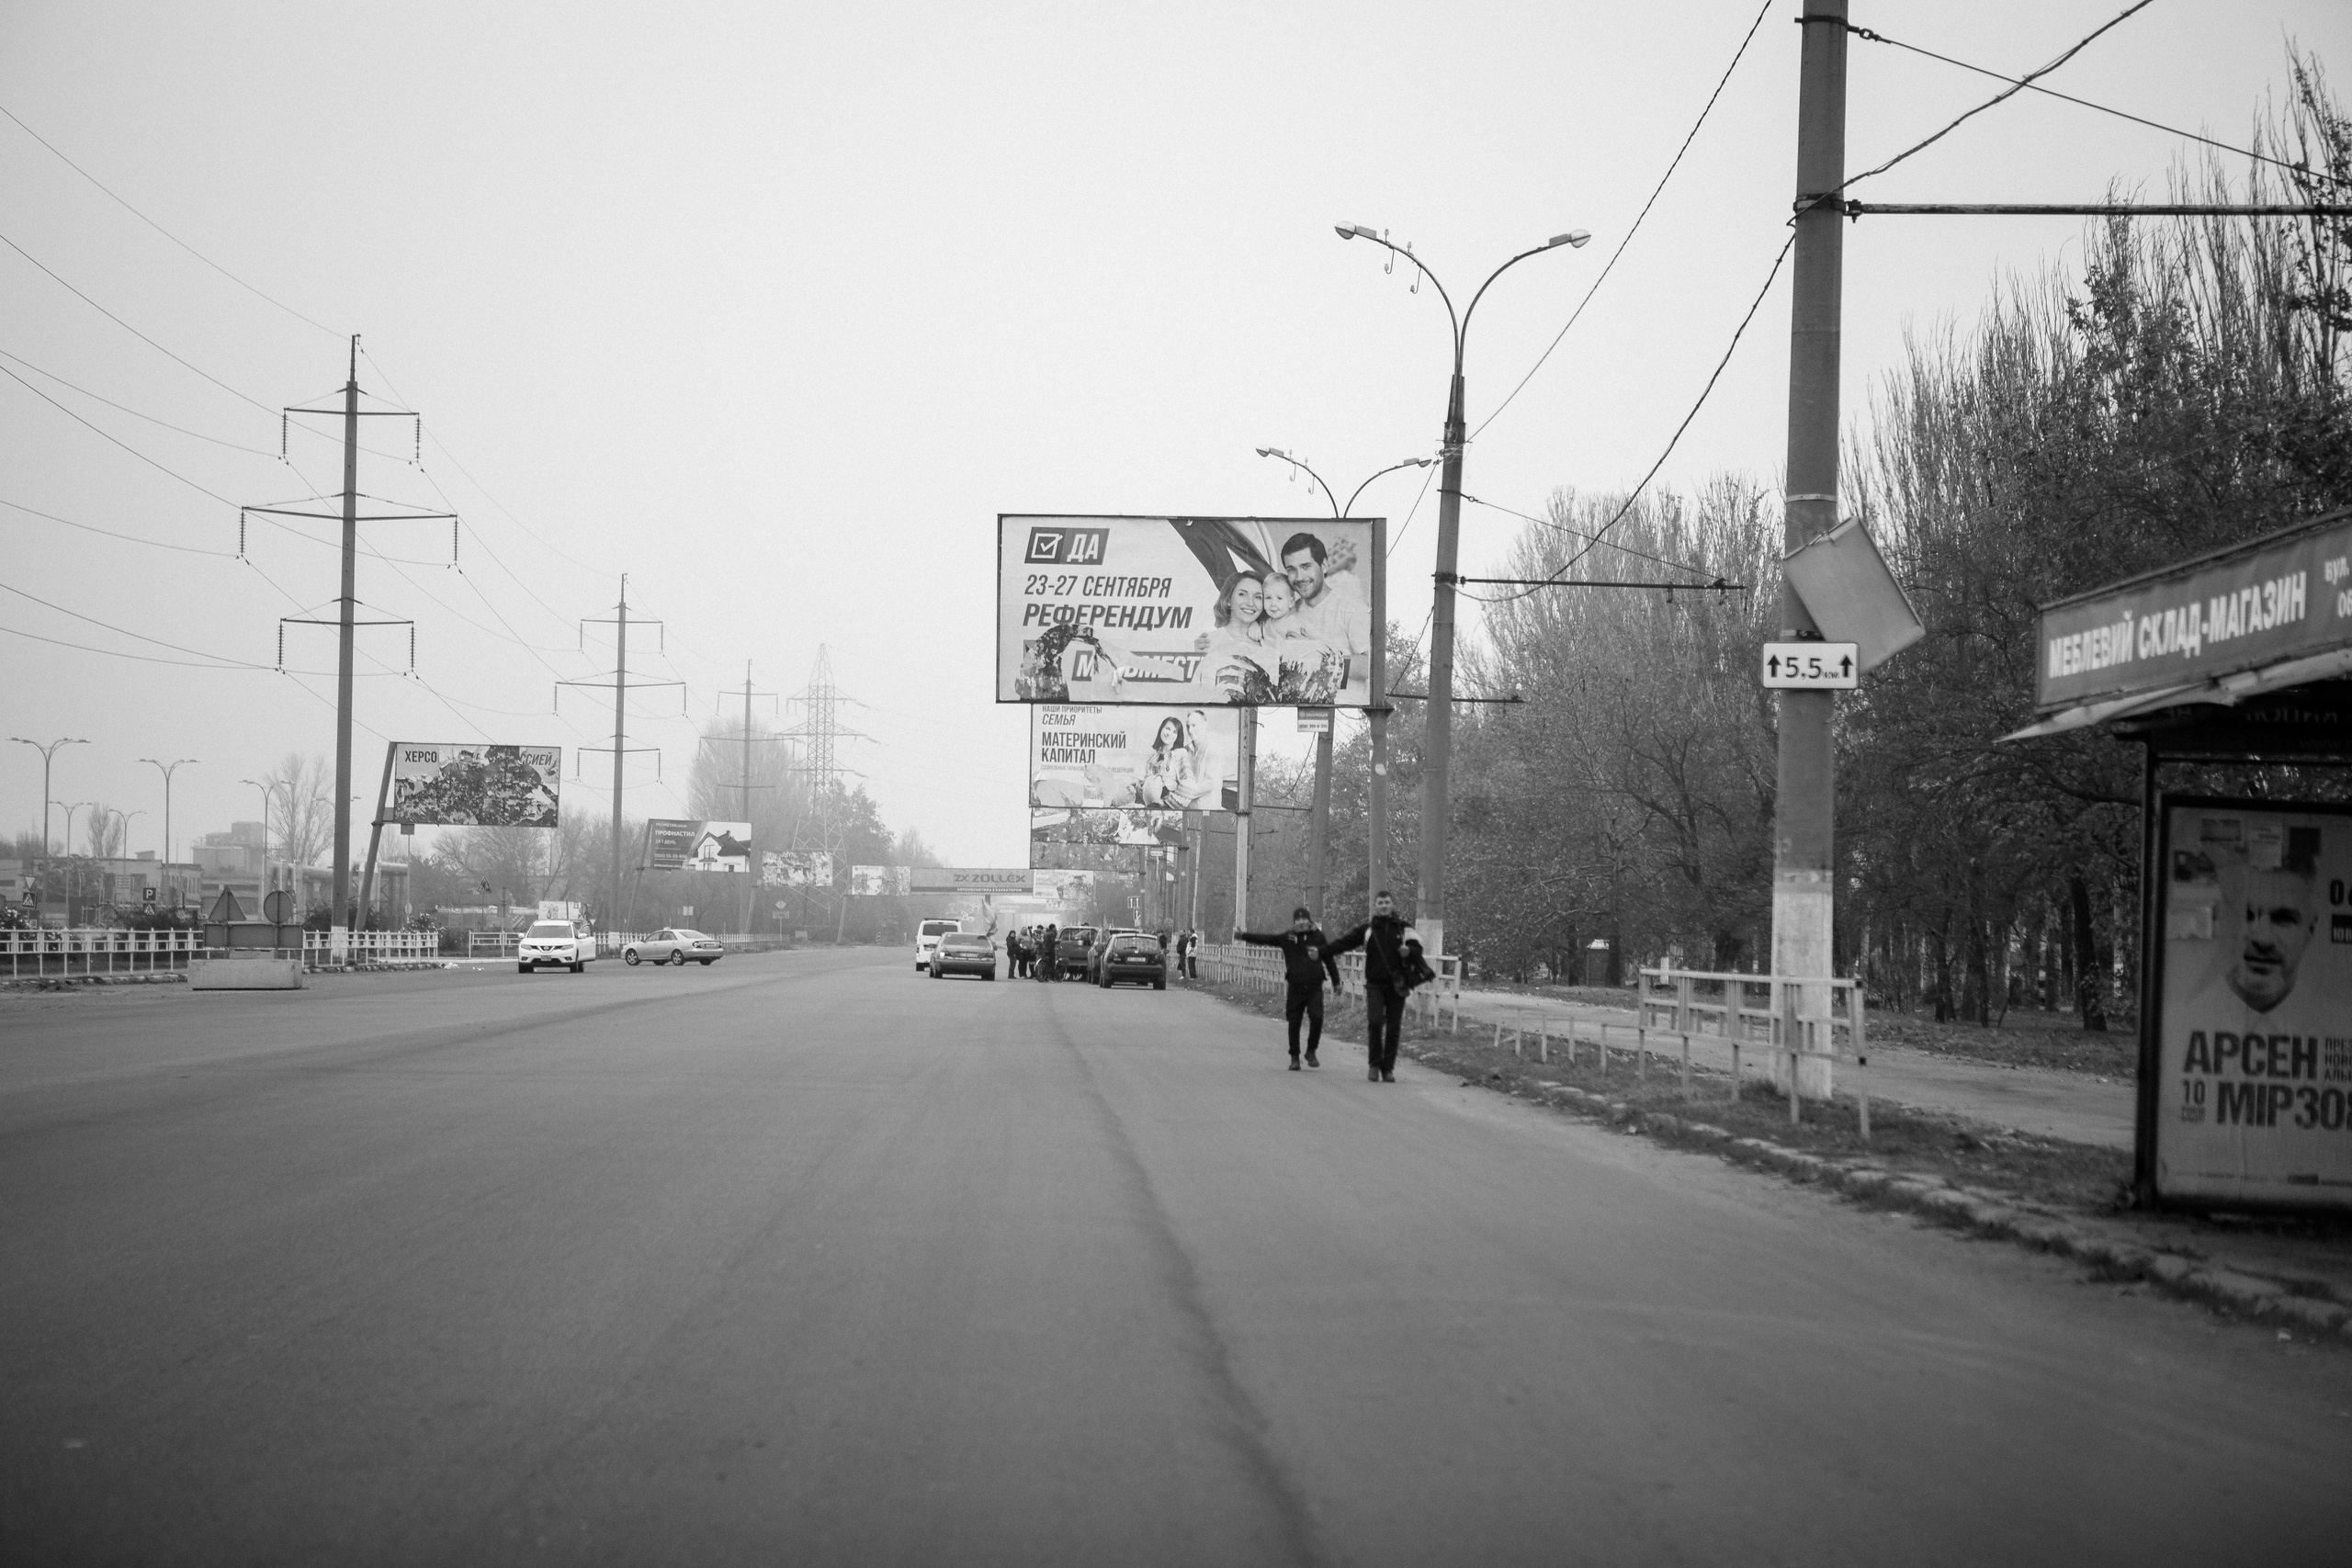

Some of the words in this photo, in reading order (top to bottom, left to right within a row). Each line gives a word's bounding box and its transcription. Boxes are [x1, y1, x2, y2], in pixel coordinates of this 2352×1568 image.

[1067, 533, 1099, 563] ДА
[1024, 574, 1078, 597] 23-27
[1082, 575, 1172, 599] СЕНТЯБРЯ
[1023, 603, 1193, 632] РЕФЕРЕНДУМ
[2048, 610, 2134, 679] МЕБЛЕВИЙ
[2138, 571, 2307, 660] СКЛАД-МАГАЗИН
[1076, 654, 1096, 678] М
[1785, 657, 1822, 680] 5,5
[1042, 714, 1076, 726] СЕМЬЯ
[1062, 705, 1102, 714] ПРИОРИТЕТЫ
[1042, 731, 1126, 749] МАТЕРИНСКИЙ
[404, 750, 437, 763] ХЕРСО
[521, 751, 552, 765] ССИЕЙ
[1042, 748, 1095, 763] КАПИТАЛ
[972, 874, 1025, 883] ZOLLEX
[146, 889, 153, 898] P
[2184, 1031, 2318, 1080] АРСЕН
[2182, 1079, 2205, 1106] 10
[2217, 1081, 2352, 1132] МІРЗО
